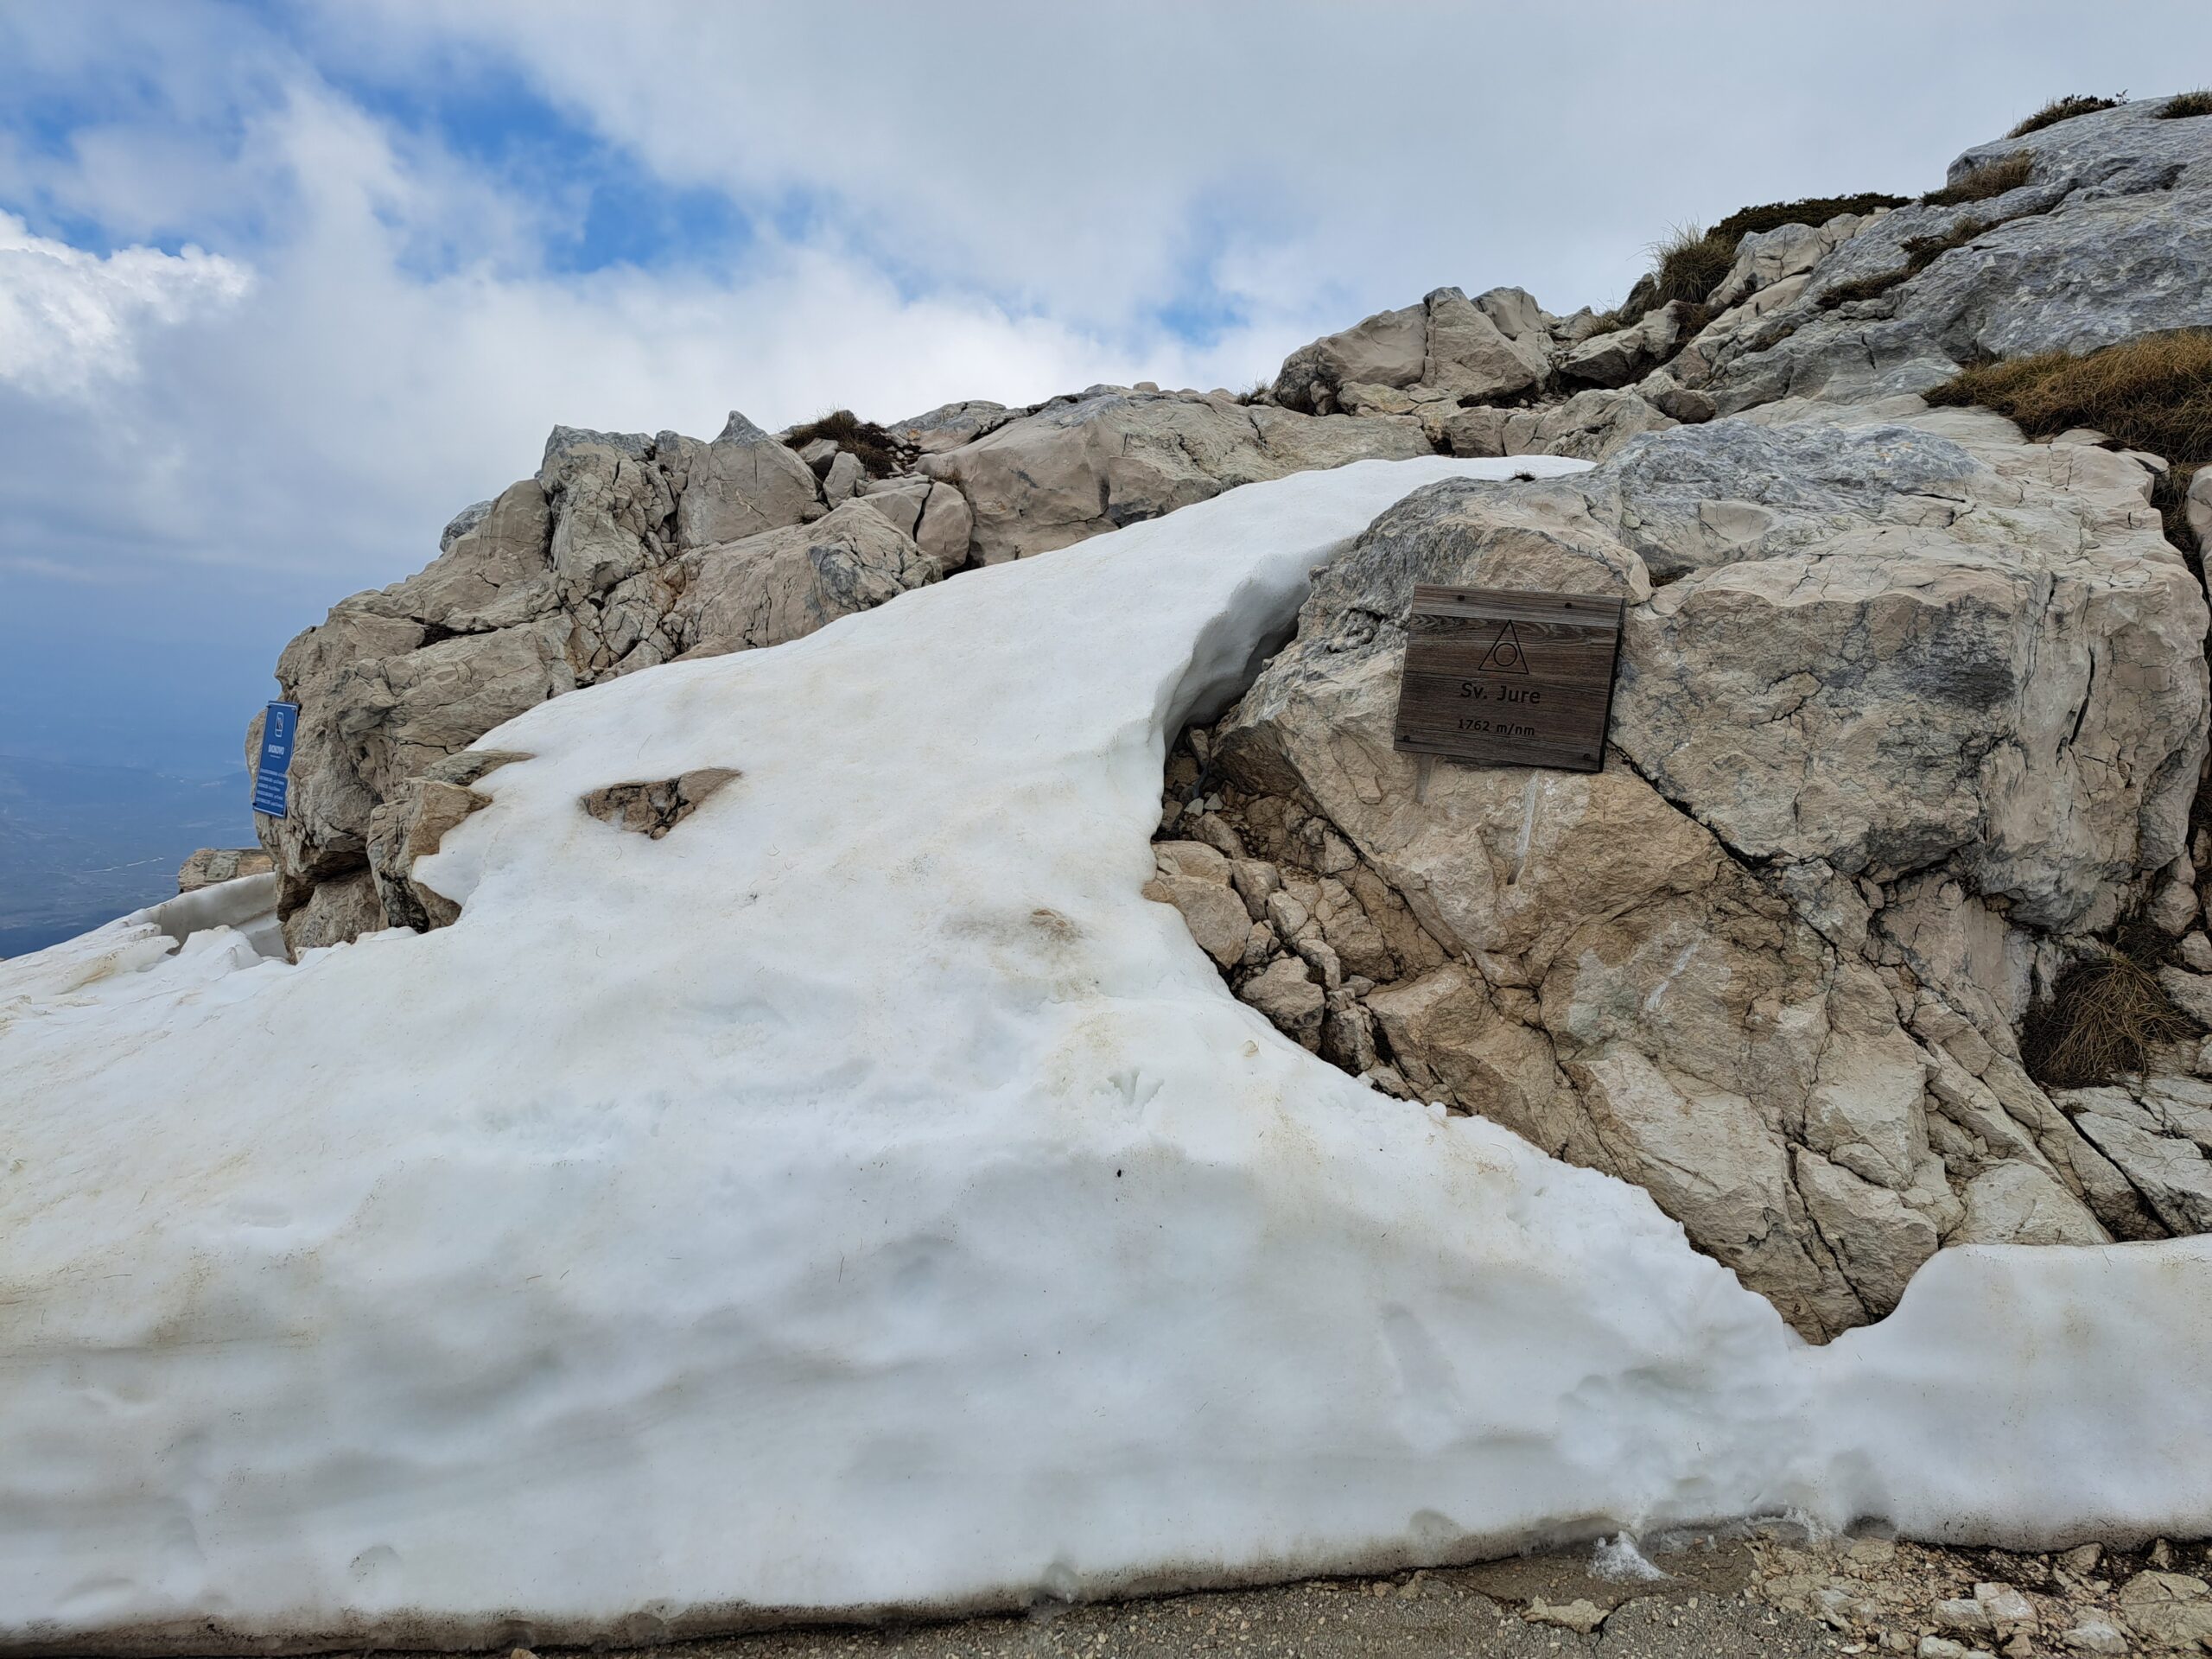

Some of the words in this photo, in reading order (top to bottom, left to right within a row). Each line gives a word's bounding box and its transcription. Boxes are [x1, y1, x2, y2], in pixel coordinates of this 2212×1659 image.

[1460, 682, 1487, 699] Sv.
[1497, 685, 1541, 704] Jure
[1458, 718, 1490, 732] 1762
[1497, 723, 1535, 736] m/nm
